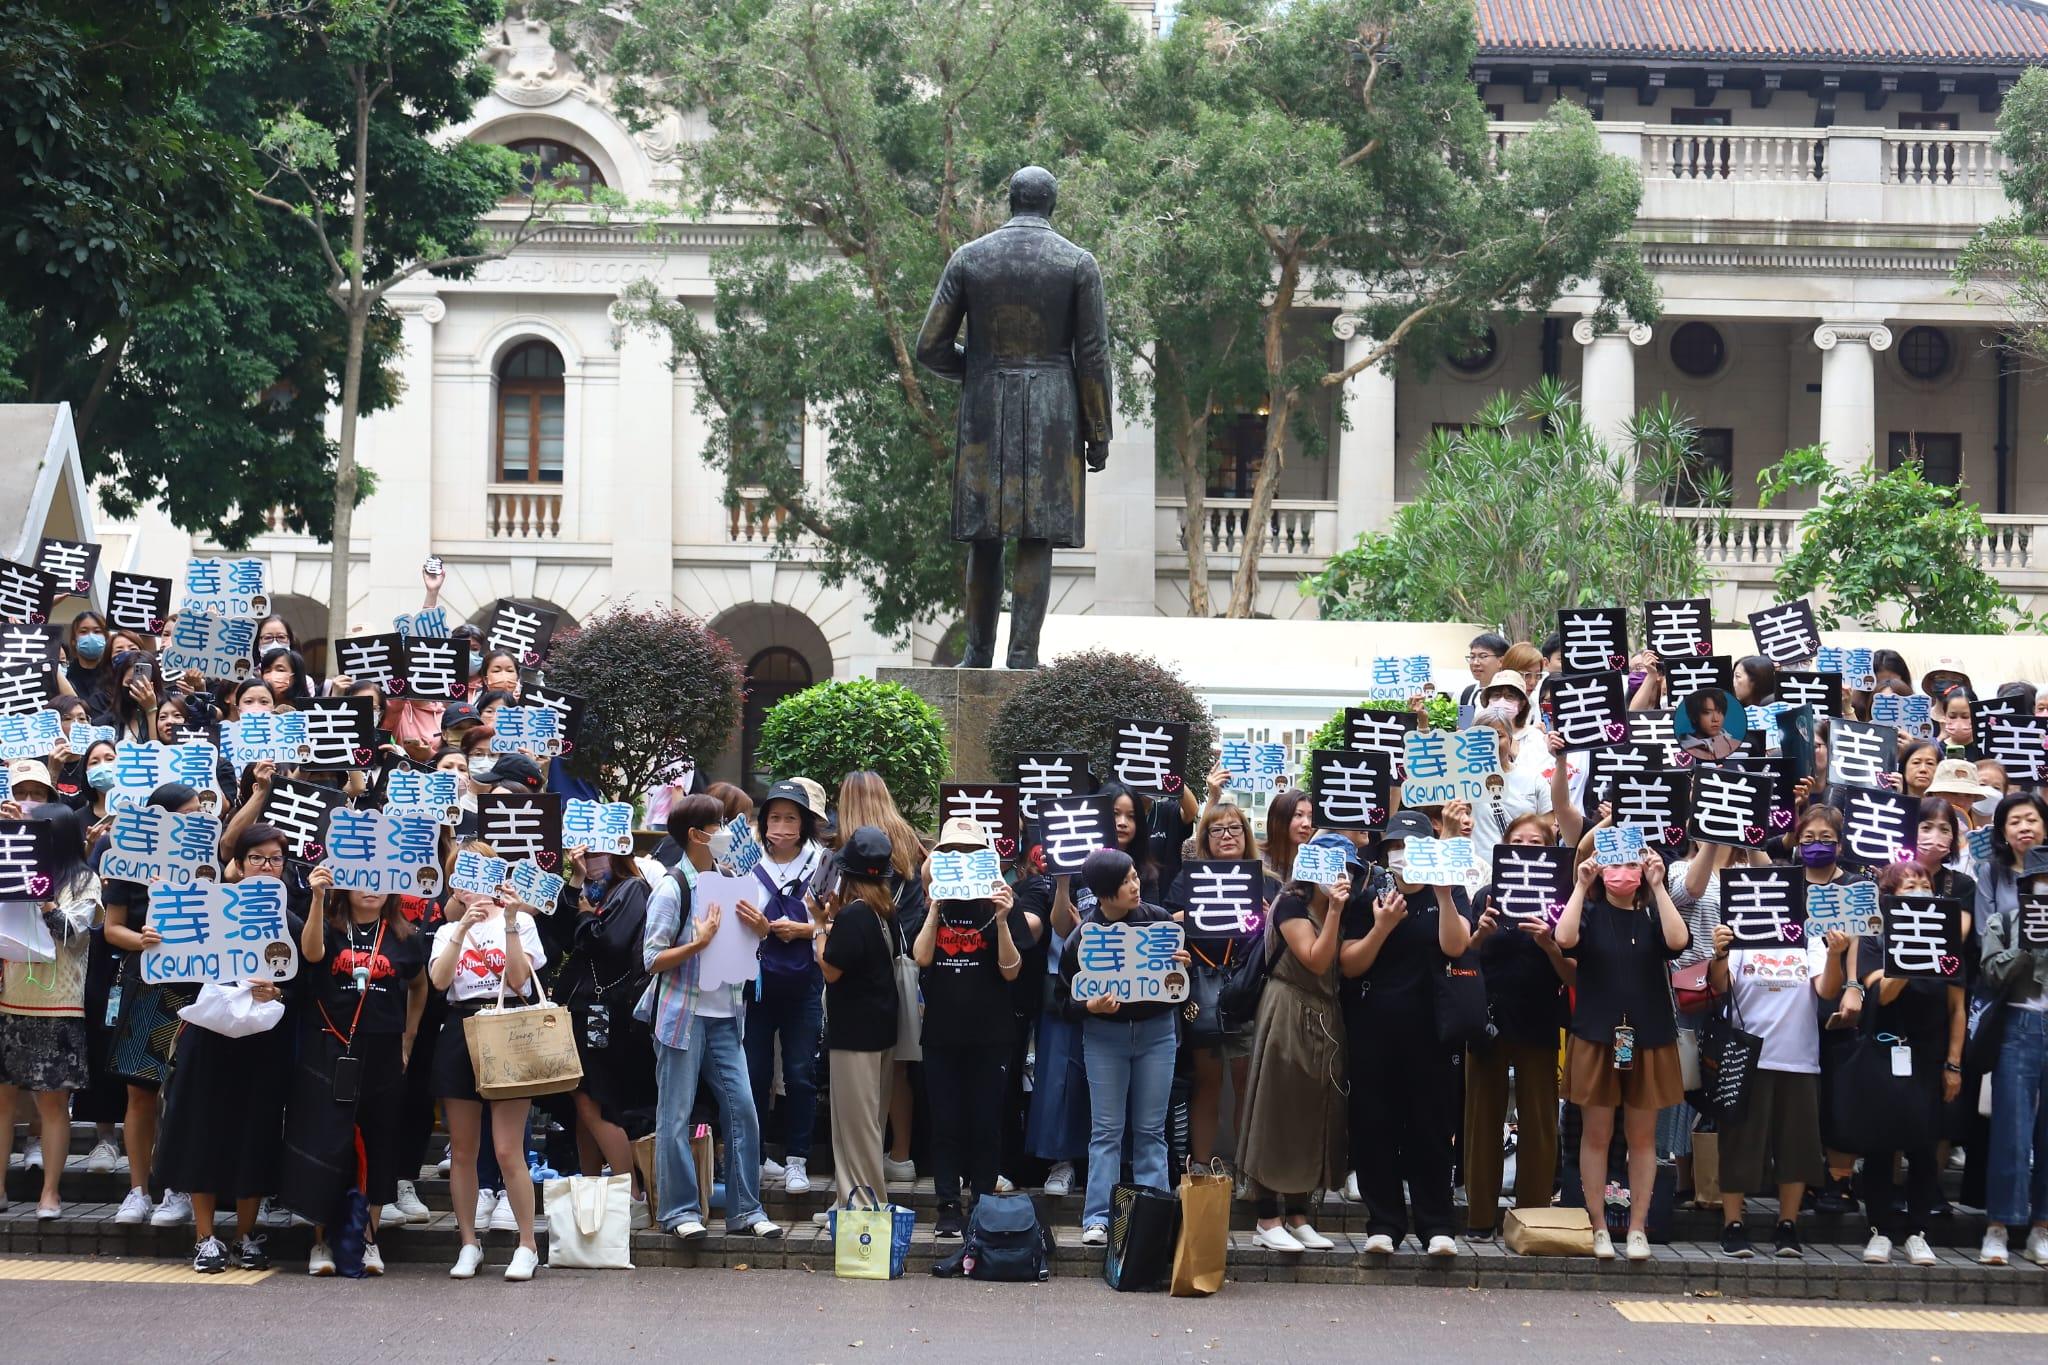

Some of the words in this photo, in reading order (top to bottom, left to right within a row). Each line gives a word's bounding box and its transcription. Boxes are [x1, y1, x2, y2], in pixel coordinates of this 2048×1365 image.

[41, 541, 89, 592] 姜
[187, 558, 264, 596] 姜濤
[0, 565, 44, 625] 姜
[110, 577, 160, 635] 姜
[231, 599, 248, 614] To
[176, 613, 256, 658] 姜濤
[488, 606, 542, 664] 姜
[1564, 613, 1615, 673] 姜
[1650, 602, 1702, 660] 姜
[1755, 606, 1811, 662] 姜
[164, 655, 208, 674] Keung
[213, 659, 231, 675] To
[342, 640, 397, 695] 姜
[407, 643, 459, 699] 姜
[1374, 655, 1432, 685] 姜濤
[1817, 647, 1873, 675] 姜濤
[1370, 686, 1405, 701] Keung
[1409, 686, 1422, 699] To
[1848, 675, 1862, 689] To
[495, 706, 559, 739] 姜濤
[1554, 678, 1613, 745] 姜
[1873, 694, 1931, 724] 姜濤
[0, 711, 60, 744] 姜濤
[240, 714, 309, 747] 姜濤
[303, 702, 359, 765] 姜
[1905, 723, 1919, 737] To
[0, 743, 43, 760] Keung
[46, 739, 59, 754] To
[237, 747, 276, 765] Keung
[280, 747, 297, 762] To
[491, 738, 528, 753] Keung
[532, 738, 546, 753] To
[1114, 723, 1174, 790] 姜
[1221, 741, 1285, 775] 姜濤
[1406, 731, 1500, 779] 姜濤
[1831, 724, 1885, 786] 姜
[1990, 718, 2046, 781] 姜
[117, 743, 215, 790] 姜濤
[111, 792, 150, 812] Keun
[387, 772, 458, 806] 姜濤
[1018, 758, 1073, 819] 姜
[1258, 776, 1274, 793] To
[1319, 759, 1377, 824] 姜
[1404, 782, 1450, 808] Keung
[1461, 778, 1483, 801] To
[263, 783, 327, 858] 姜
[428, 806, 445, 822] To
[566, 802, 630, 836] 姜濤
[1616, 776, 1676, 843] 姜
[1694, 773, 1757, 841] 姜
[115, 806, 219, 864] 姜濤
[327, 810, 436, 867] 姜濤
[484, 800, 546, 868] 姜
[1044, 800, 1105, 866] 姜
[1597, 824, 1644, 855] 姜濤
[1847, 793, 1907, 864] 姜
[601, 839, 616, 854] To
[1299, 847, 1346, 875] 姜濤
[1404, 839, 1475, 874] 姜濤
[1627, 849, 1641, 863] To
[103, 855, 160, 884] Keung
[168, 865, 190, 888] To
[331, 866, 381, 891] eung
[390, 867, 412, 891] To
[458, 853, 508, 884] 姜濤
[514, 860, 562, 902] 姜濤
[932, 851, 1000, 882] 姜濤
[1296, 868, 1323, 883] Keung
[1326, 872, 1337, 884] To
[1404, 869, 1444, 888] Keung
[1448, 870, 1465, 887] To
[450, 876, 480, 896] Keung
[482, 881, 496, 895] To
[930, 882, 970, 899] Keung
[976, 881, 991, 895] To
[1189, 865, 1252, 933] 姜
[1496, 849, 1557, 921] 姜
[1808, 884, 1877, 920] 姜濤
[152, 880, 285, 945] 姜濤
[1727, 872, 1792, 942] 姜
[1850, 917, 1867, 934] To
[1889, 902, 1947, 973] 姜
[146, 951, 220, 981] Keung
[227, 950, 259, 977] To
[1082, 926, 1181, 972] 姜濤
[1075, 975, 1131, 998] Keung
[1139, 976, 1160, 998] To
